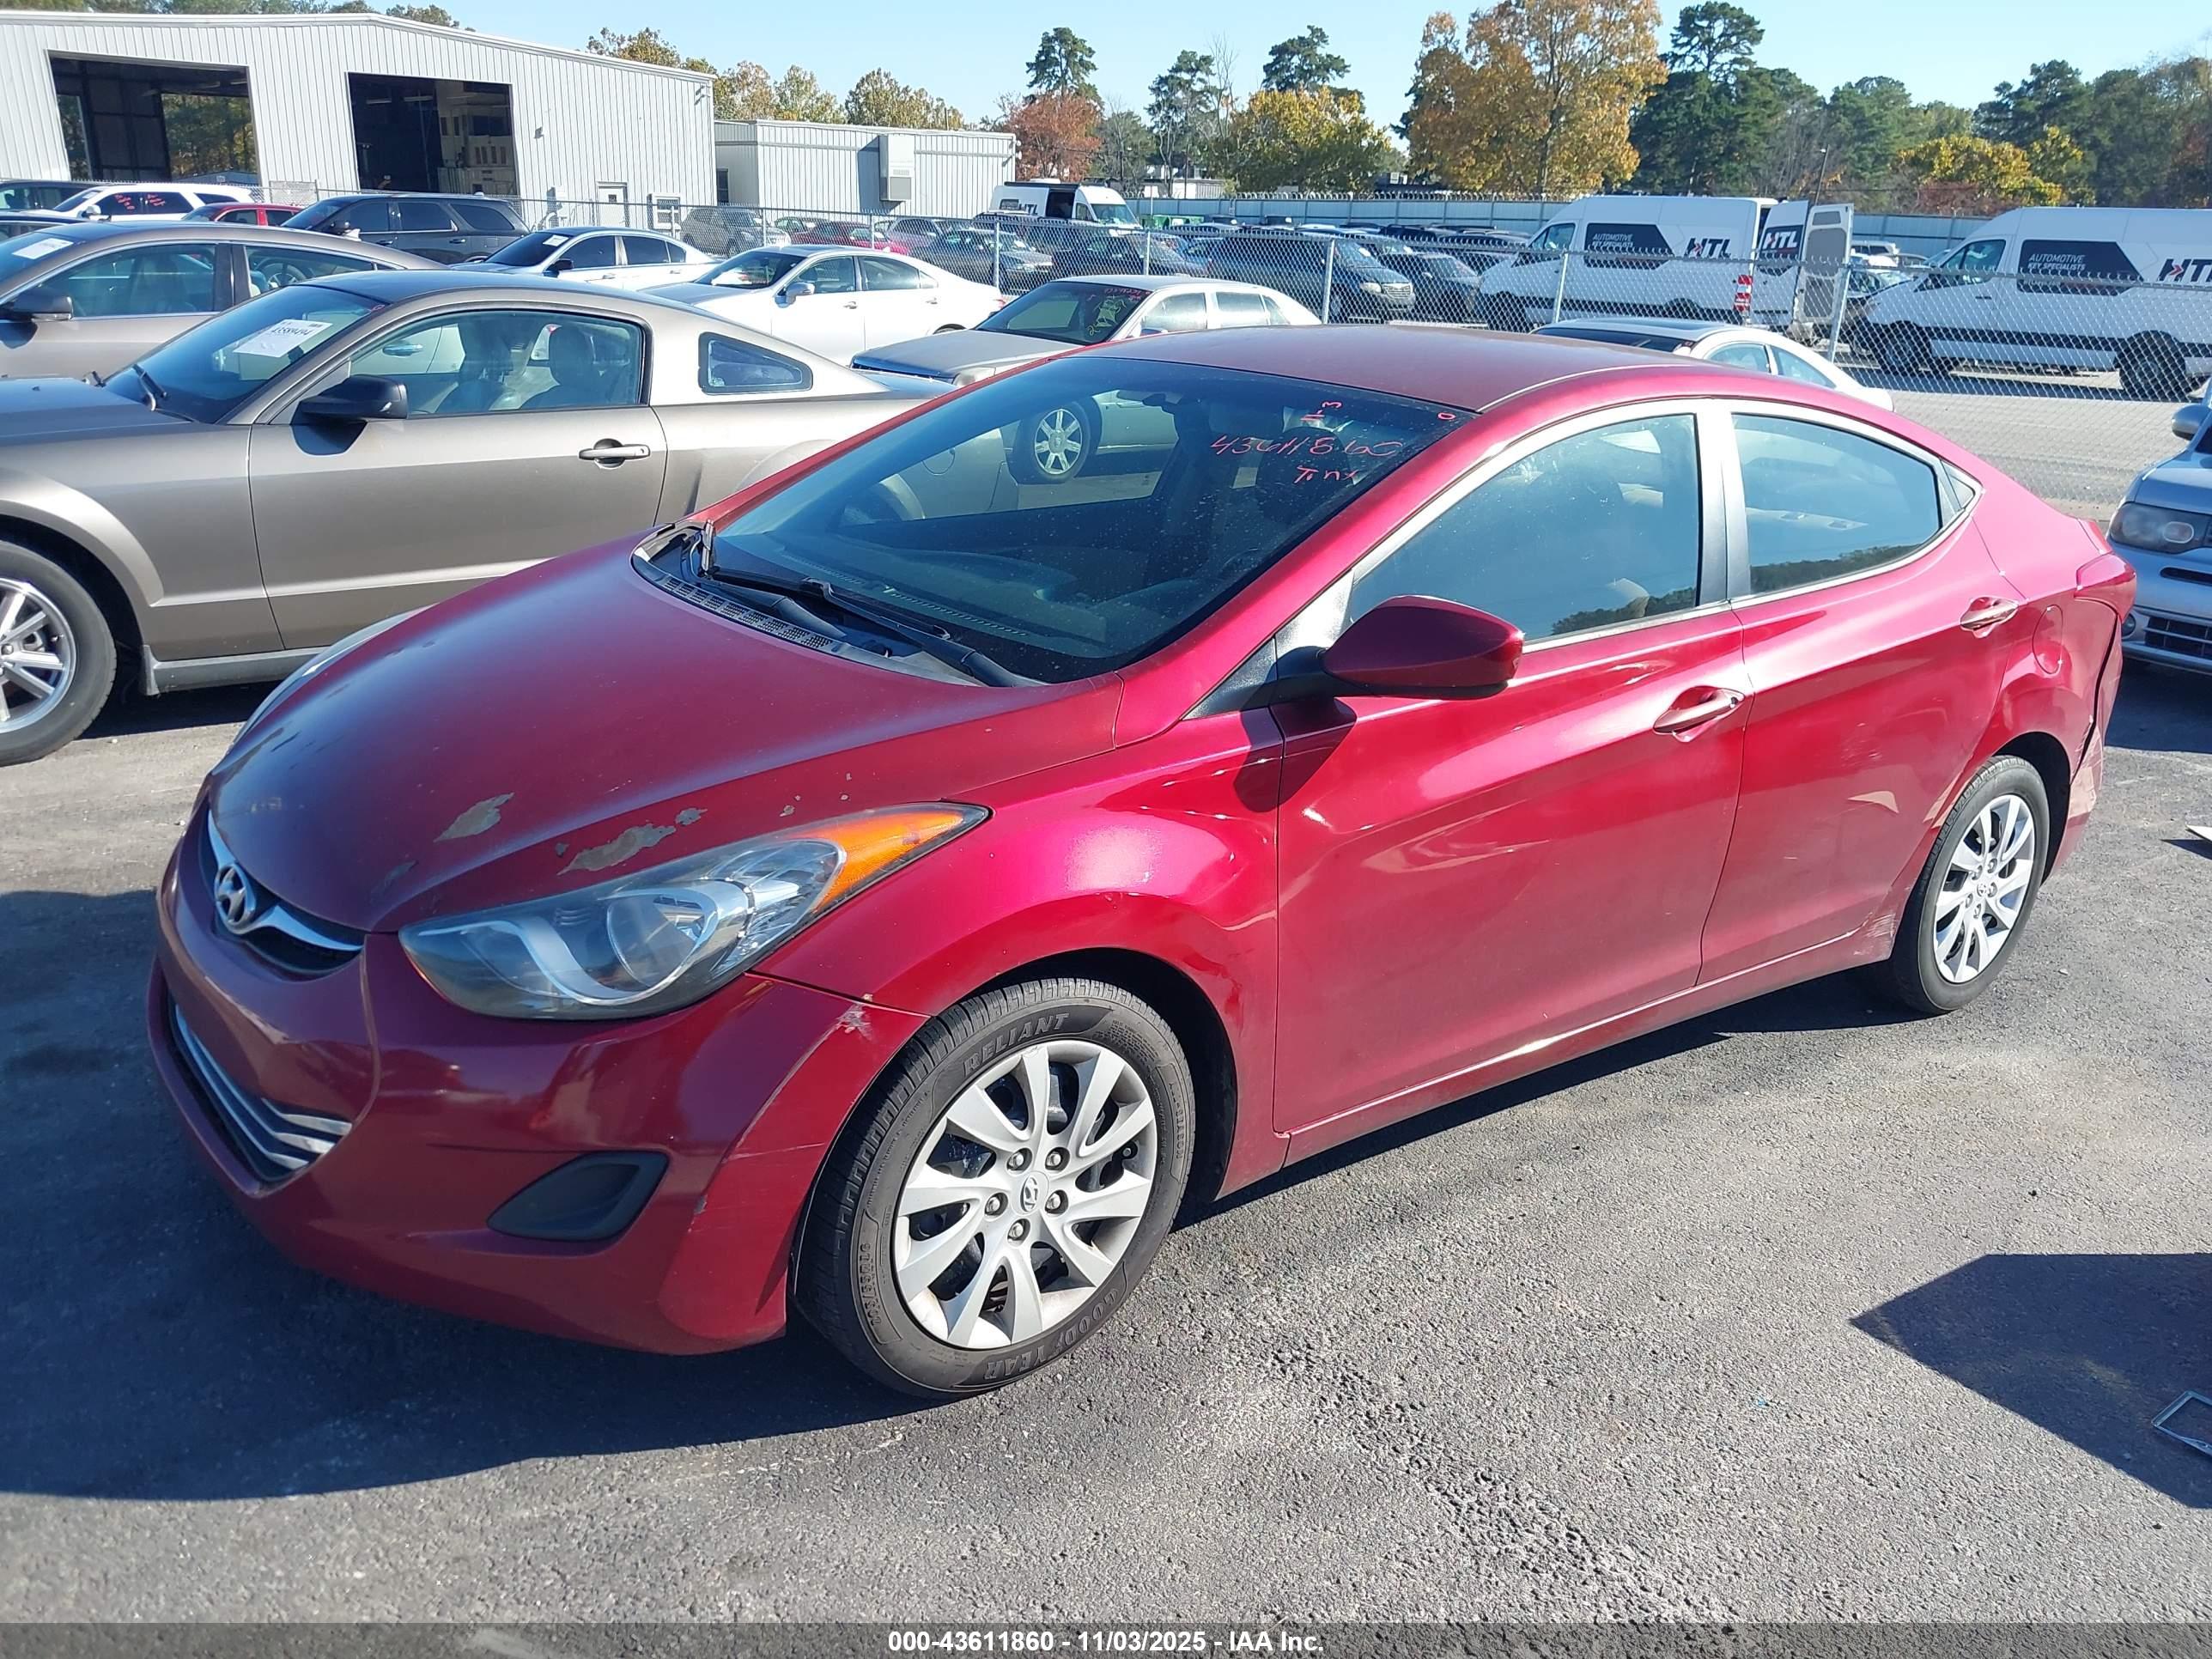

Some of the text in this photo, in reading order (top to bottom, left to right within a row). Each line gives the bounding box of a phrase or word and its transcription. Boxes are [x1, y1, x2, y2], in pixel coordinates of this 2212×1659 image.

[1592, 233, 1633, 241] AUTOMOTIVE
[1762, 231, 1797, 248] HTL
[1684, 237, 1732, 258] HTL
[2028, 253, 2086, 263] AUTOMOTIVE
[2044, 263, 2086, 271] SPECIALISTS
[2155, 258, 2212, 283] HT
[963, 1012, 1071, 1075] RELIANT
